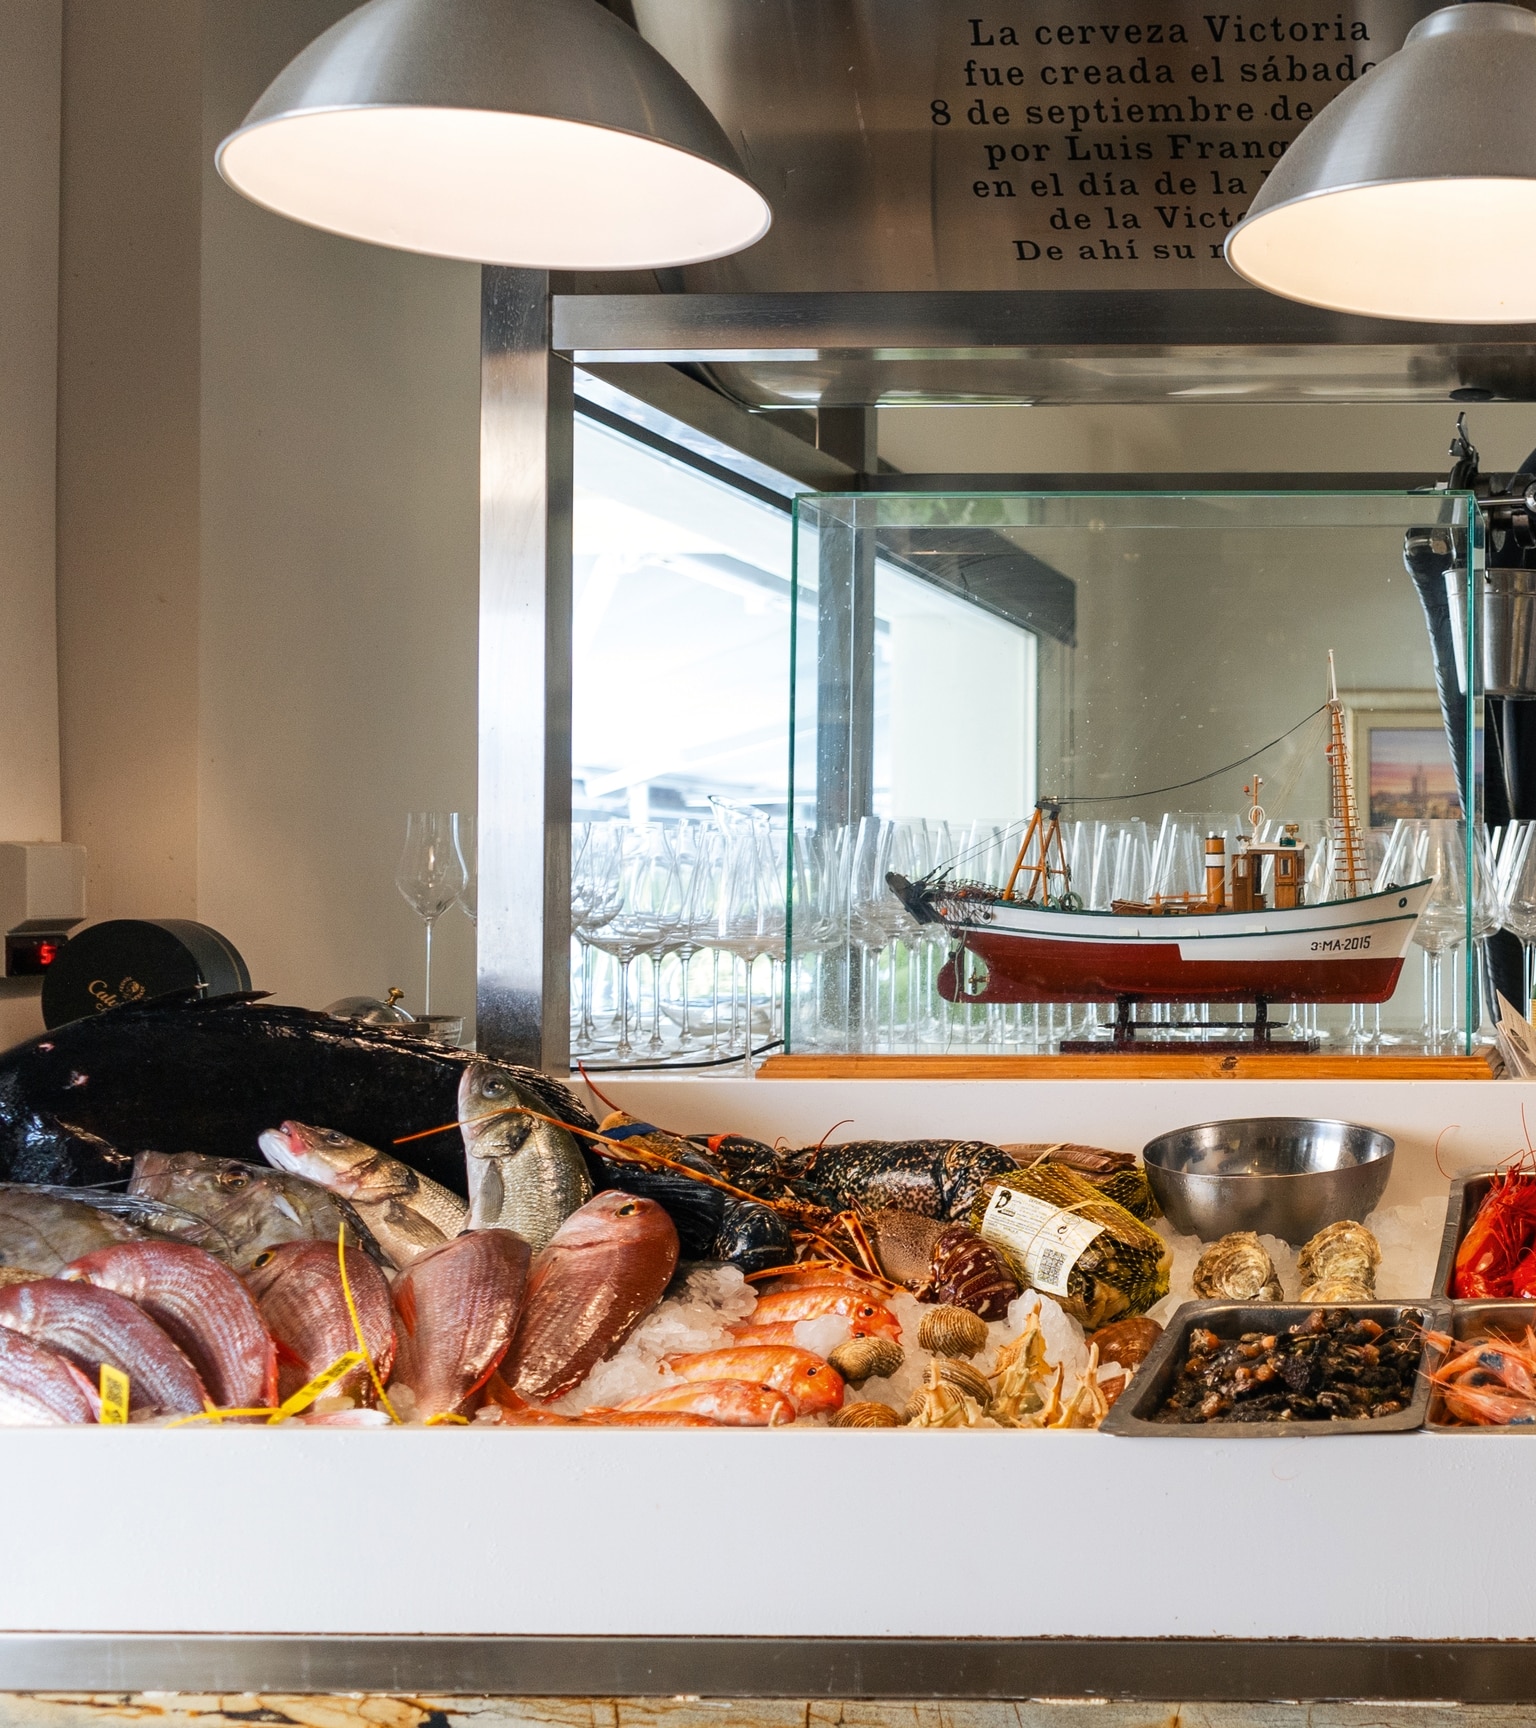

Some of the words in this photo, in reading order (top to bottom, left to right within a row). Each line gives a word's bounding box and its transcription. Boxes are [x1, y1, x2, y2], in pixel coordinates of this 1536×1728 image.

[967, 18, 1020, 47] La
[1035, 23, 1189, 46] cerveza
[1202, 14, 1370, 43] Victoria
[963, 59, 1024, 87] fue
[1040, 56, 1175, 86] creada
[1190, 55, 1225, 84] el
[930, 99, 951, 126] 8
[967, 98, 1010, 126] de
[1025, 95, 1254, 132] septiembre
[1270, 94, 1313, 121] de
[983, 143, 1051, 171] por
[1064, 135, 1153, 162] Luis
[972, 179, 1017, 198] en
[1030, 172, 1064, 198] el
[1078, 171, 1140, 197] día
[1154, 171, 1197, 196] de
[1210, 170, 1248, 195] la
[1049, 207, 1091, 230] de
[1104, 206, 1142, 229] la
[1012, 240, 1063, 261] De
[1078, 239, 1139, 260] ahí
[1153, 244, 1196, 260] su
